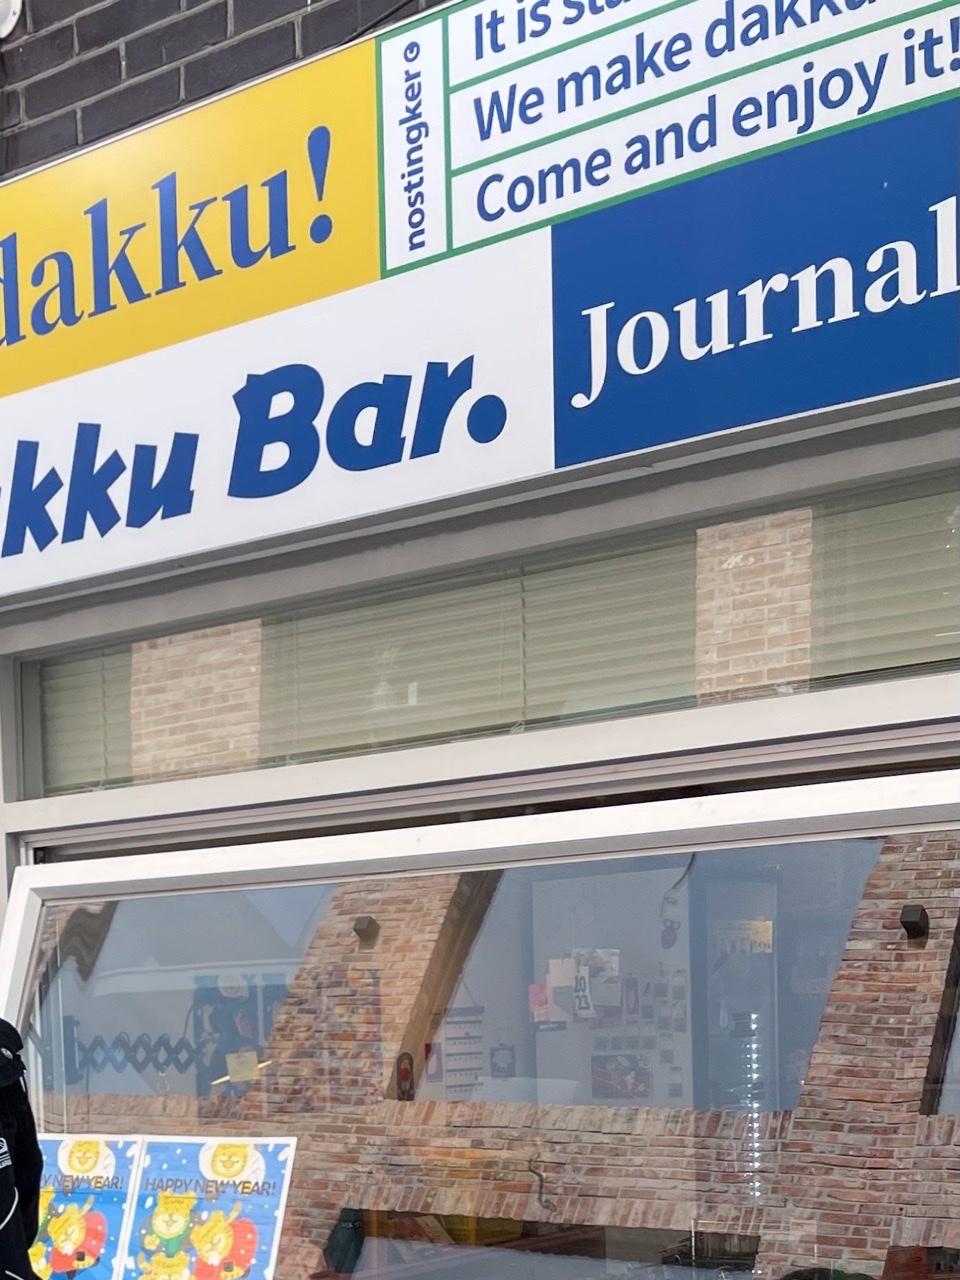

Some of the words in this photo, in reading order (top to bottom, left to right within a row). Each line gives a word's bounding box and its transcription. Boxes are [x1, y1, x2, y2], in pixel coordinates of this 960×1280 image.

[474, 11, 505, 60] It
[517, 0, 551, 43] is
[474, 85, 545, 141] We
[557, 33, 691, 112] make
[705, 0, 876, 58] dak
[398, 70, 429, 251] nostingker
[476, 150, 611, 221] Come
[625, 94, 717, 170] and
[732, 53, 889, 137] enjoy
[904, 17, 960, 85] it!
[570, 196, 960, 408] Journal
[227, 354, 507, 499] Bar.
[52, 1174, 84, 1190] NEW
[85, 1175, 124, 1191] YEAR!
[144, 1176, 193, 1193] HAPPY
[193, 1178, 231, 1195] NEW
[229, 1180, 277, 1196] YEAR!
